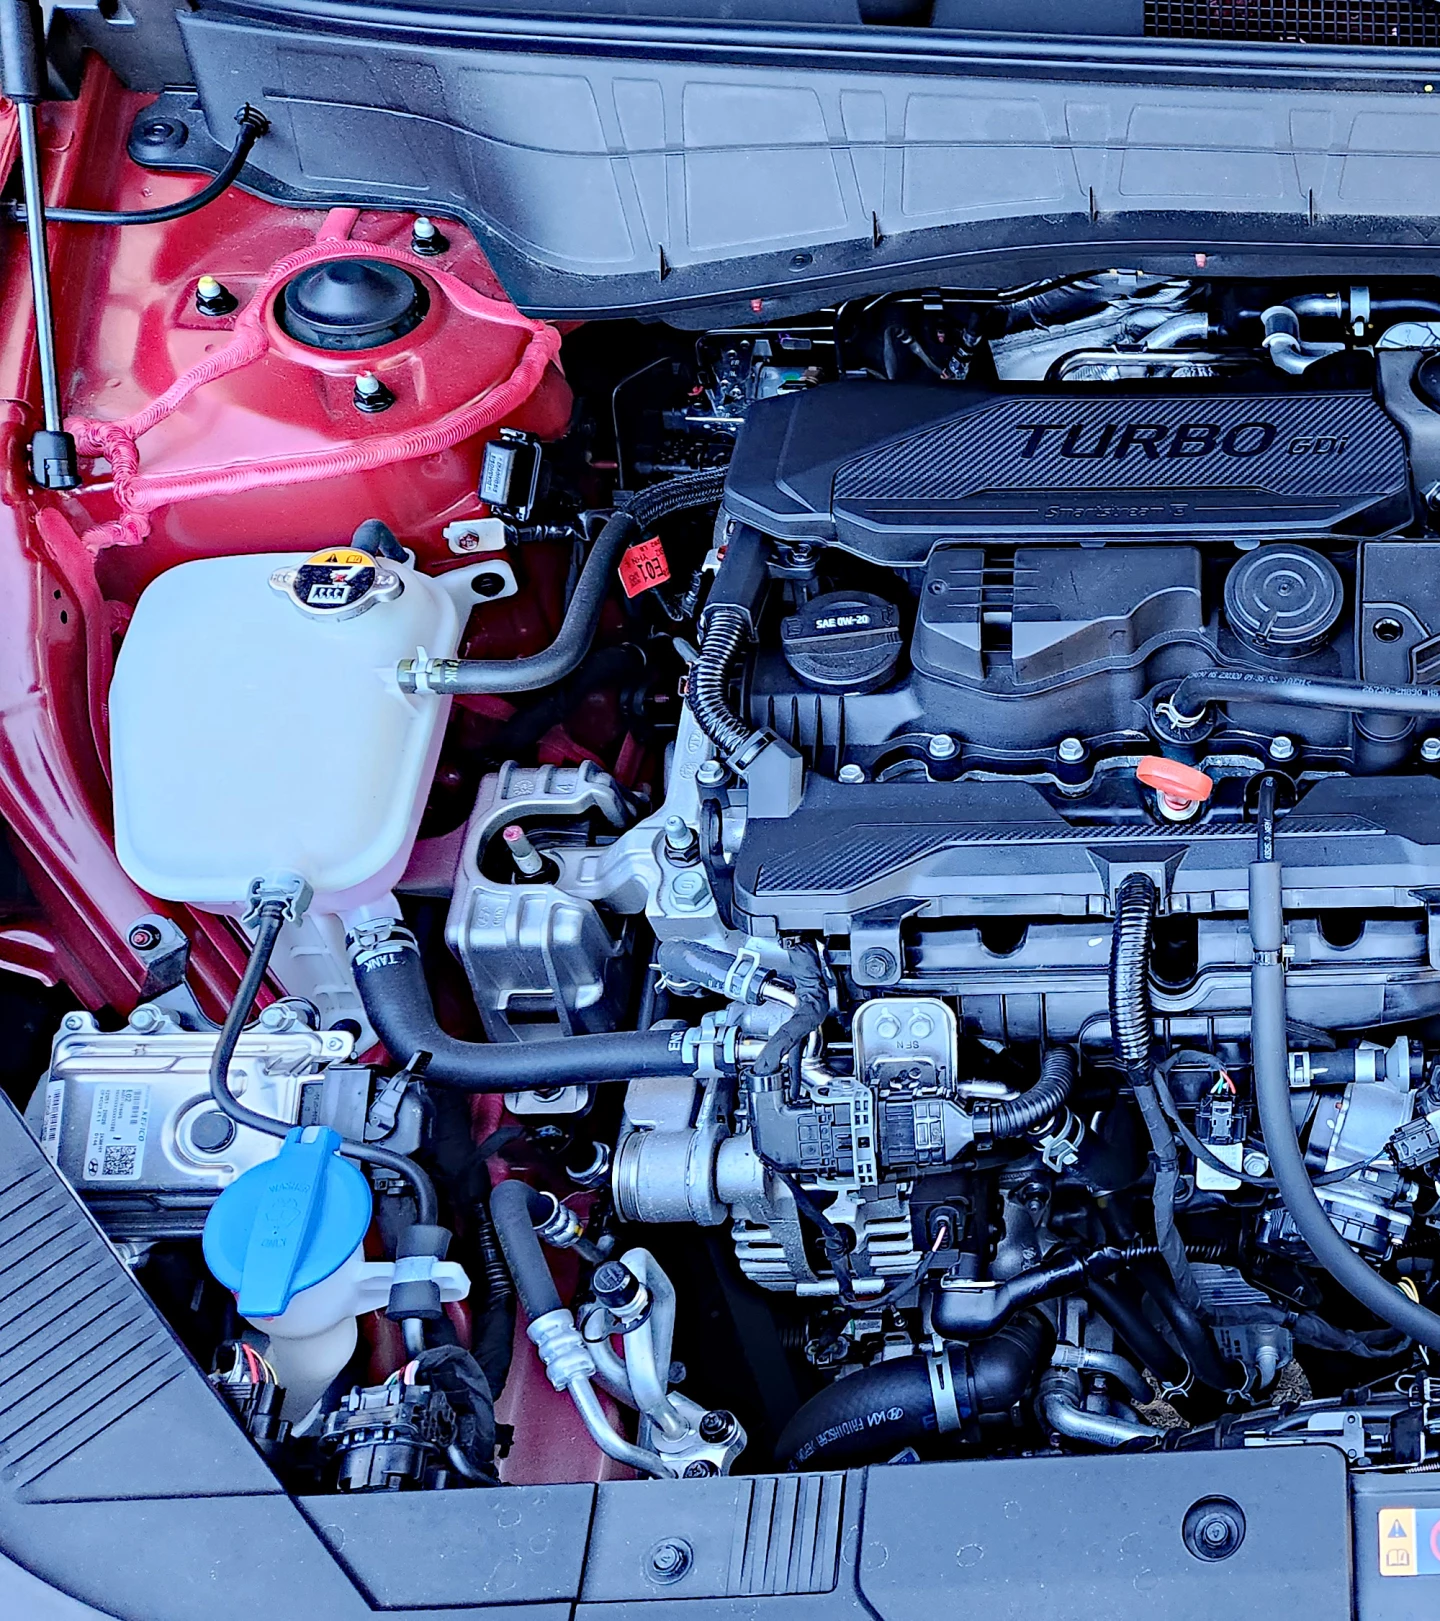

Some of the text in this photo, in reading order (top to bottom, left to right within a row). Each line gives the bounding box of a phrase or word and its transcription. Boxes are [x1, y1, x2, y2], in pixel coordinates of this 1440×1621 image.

[1016, 422, 1350, 459] TURBO GDi
[1045, 503, 1165, 518] Smartstream
[637, 557, 664, 582] E01
[816, 614, 870, 630] SAE 0W-20
[364, 953, 398, 973] TANK
[125, 1089, 133, 1102] E02
[138, 1111, 148, 1142] KEFICO
[269, 1182, 311, 1193] WASHER
[600, 1268, 618, 1287] H
